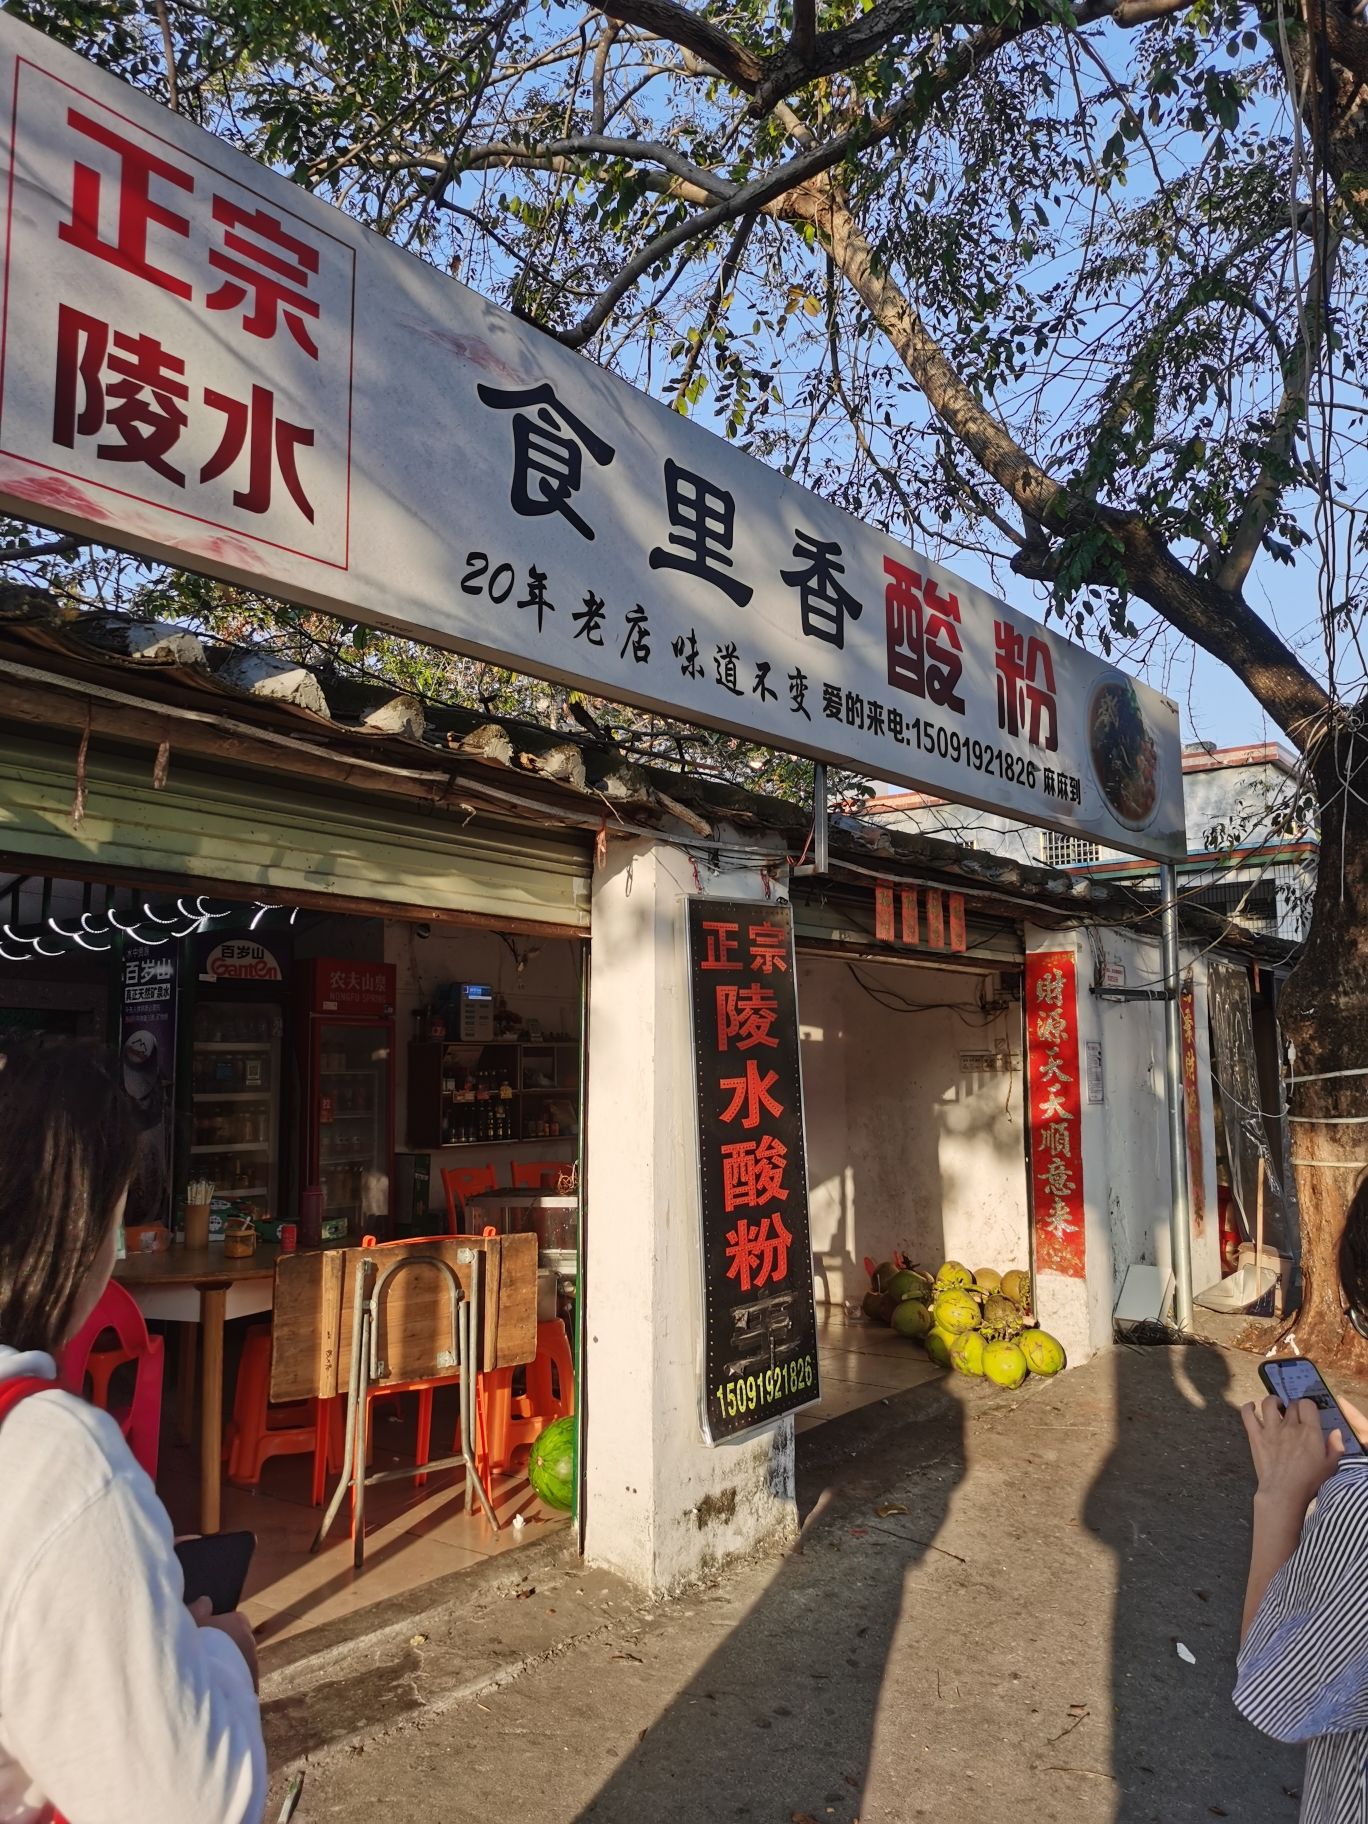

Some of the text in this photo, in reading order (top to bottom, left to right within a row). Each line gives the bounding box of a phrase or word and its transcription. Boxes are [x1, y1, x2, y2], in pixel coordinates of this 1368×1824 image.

[58, 107, 319, 361] 正宗
[53, 302, 315, 525] 陵水
[477, 383, 862, 650] 食里香
[883, 554, 1059, 752] 酸粉
[1043, 767, 1081, 805] 麻麻到
[125, 957, 172, 984] 百岁山
[220, 944, 264, 960] 百岁山
[701, 920, 788, 974] 正宗
[329, 971, 387, 992] 农夫山泉
[717, 1355, 812, 1418] 15091921826
